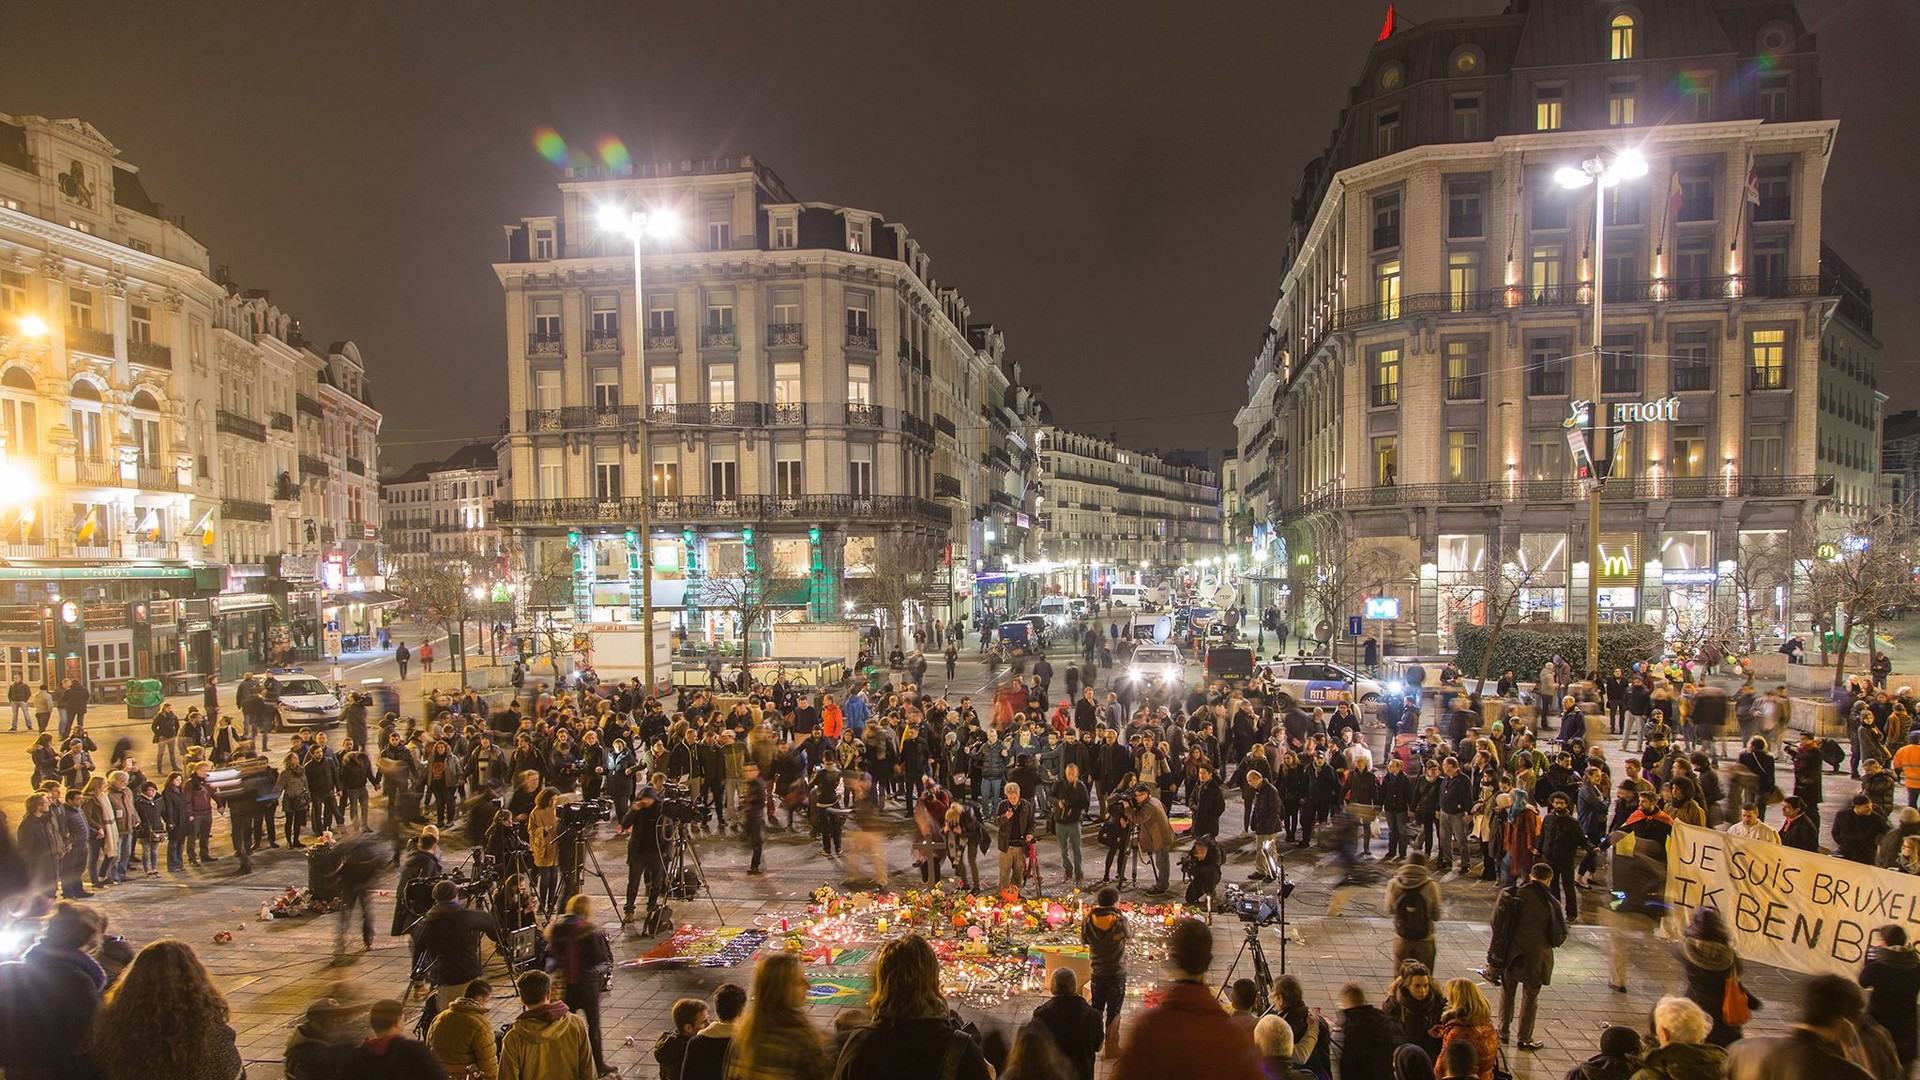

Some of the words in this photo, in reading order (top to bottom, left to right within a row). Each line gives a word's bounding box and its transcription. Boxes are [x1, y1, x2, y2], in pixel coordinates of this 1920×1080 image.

[1563, 396, 1681, 428] rriott
[1310, 690, 1325, 699] RTL
[1679, 842, 1722, 872] JE
[1674, 876, 1725, 916] IK
[1735, 892, 1823, 950] BEN
